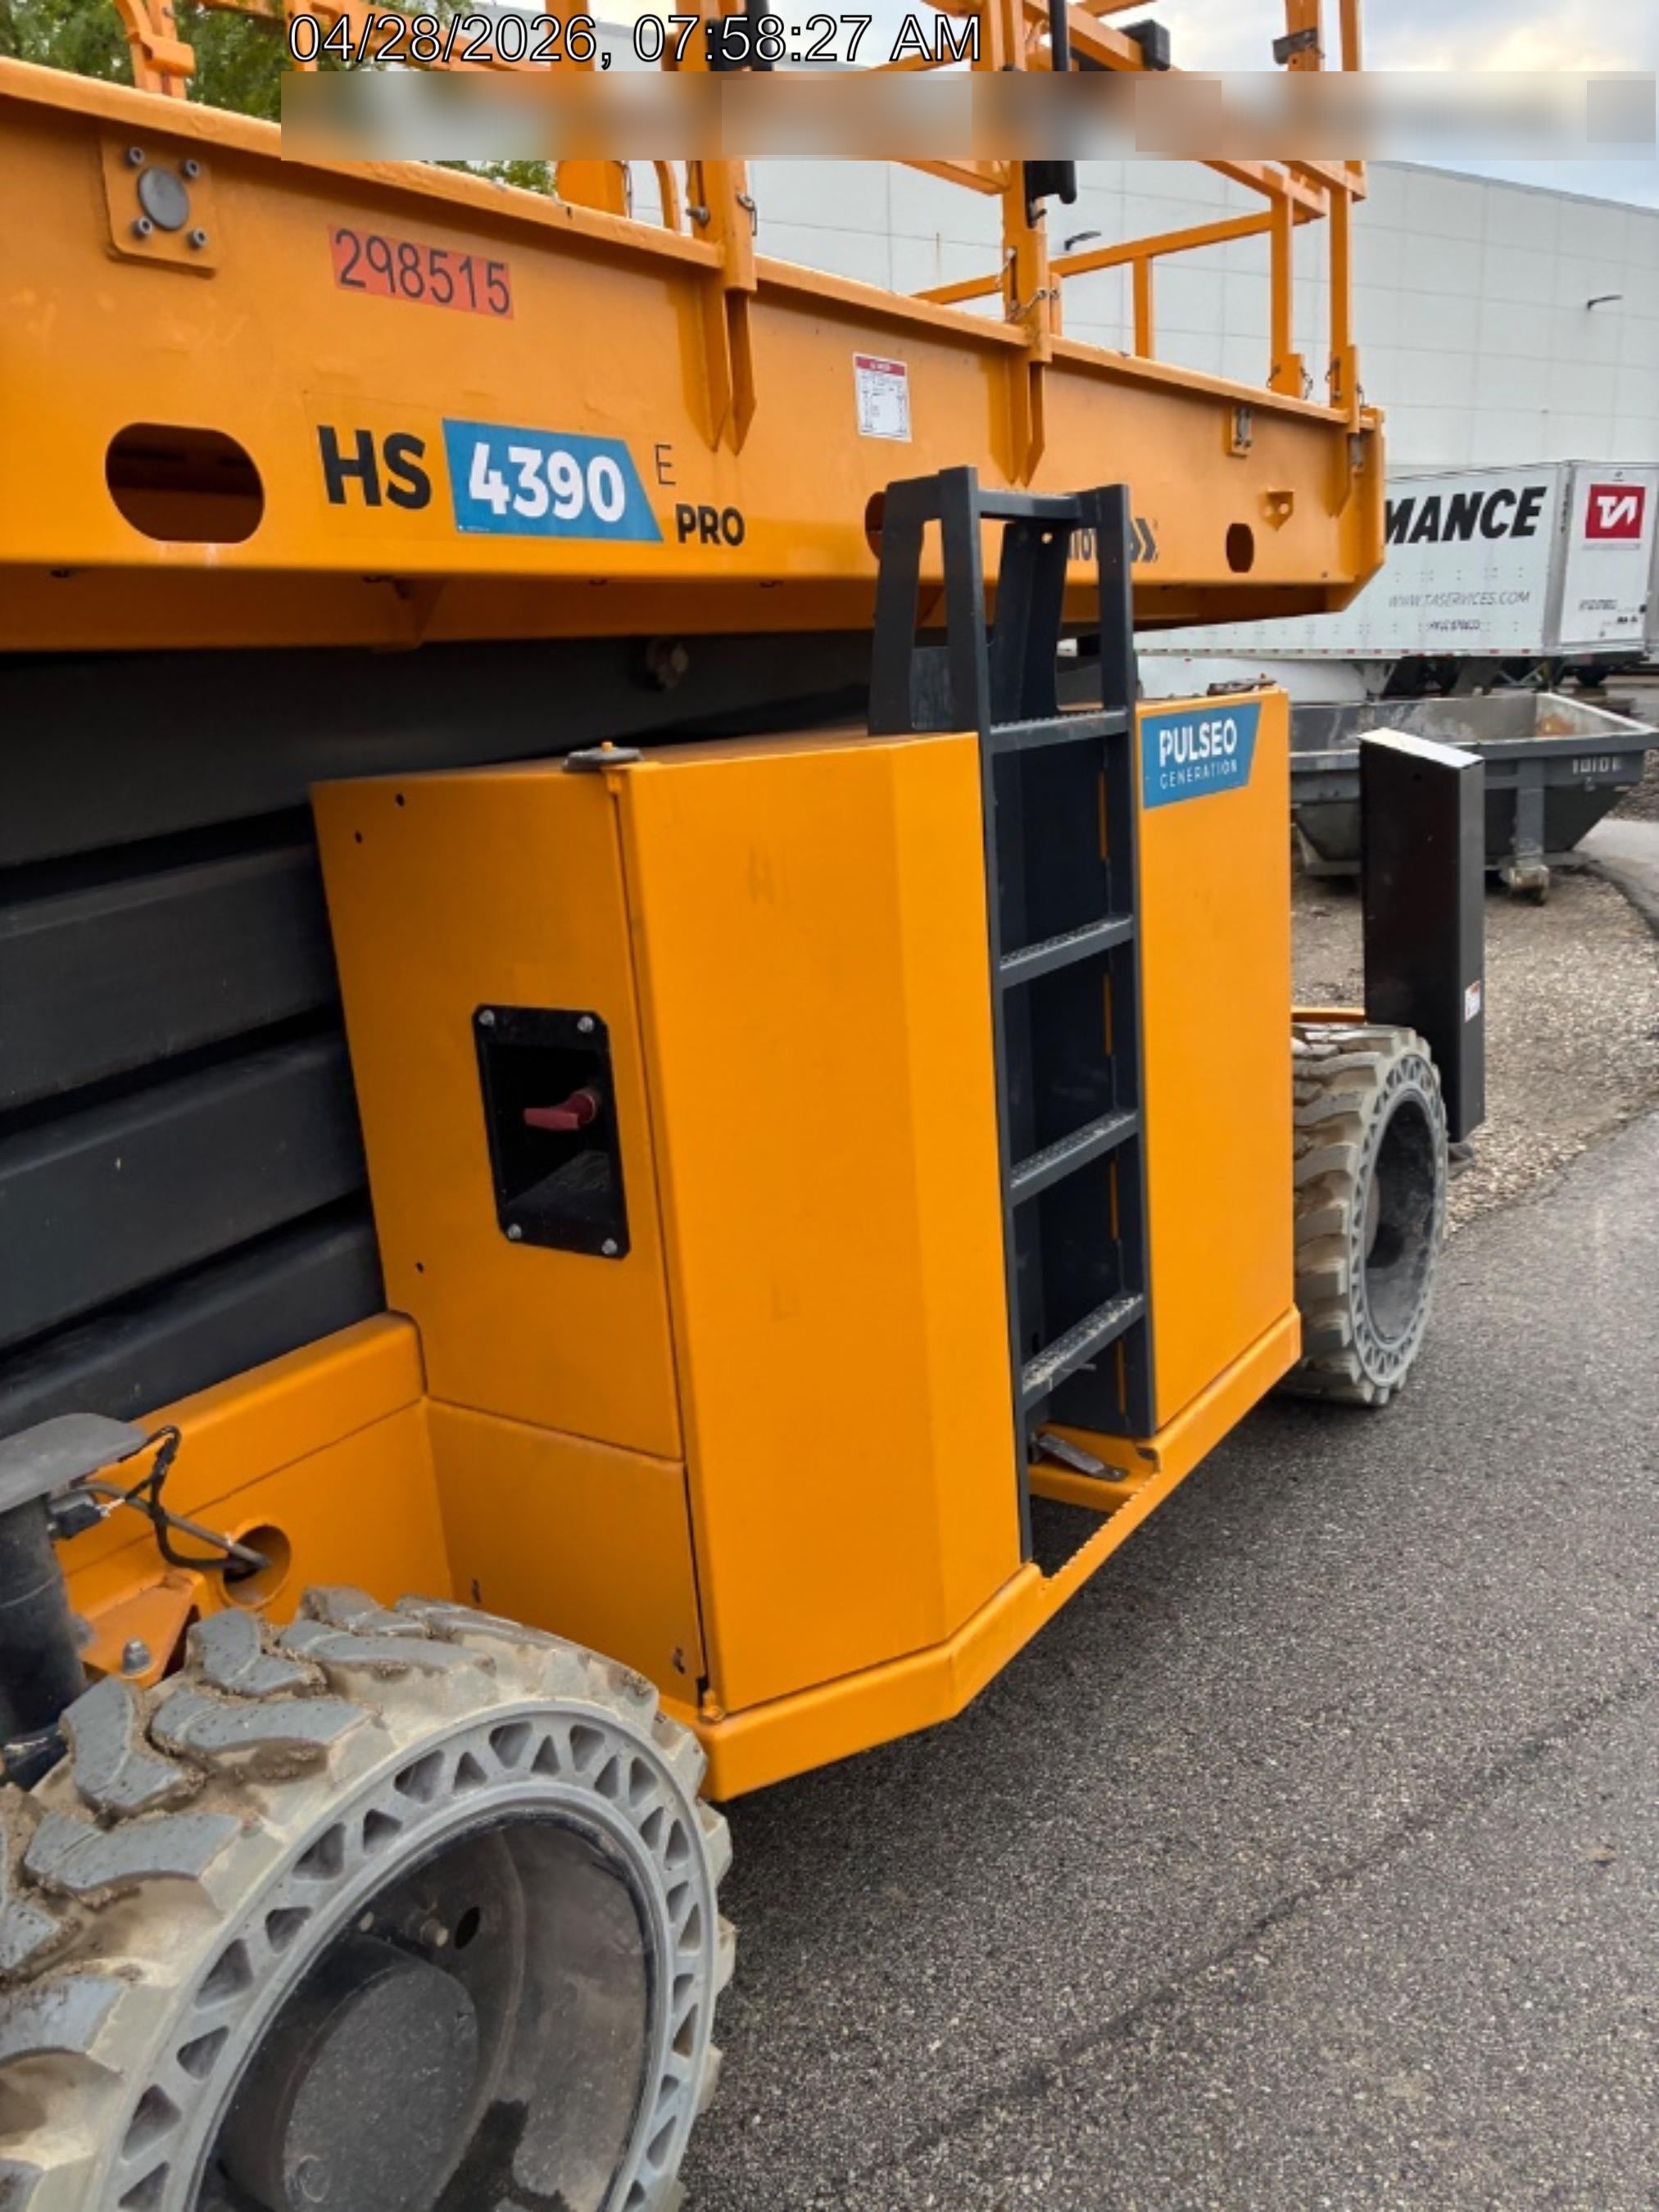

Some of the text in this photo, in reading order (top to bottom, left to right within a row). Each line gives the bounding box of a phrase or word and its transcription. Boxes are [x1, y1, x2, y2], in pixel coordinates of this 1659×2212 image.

[334, 229, 510, 315] 298515
[317, 424, 676, 523] HS 4390 E
[675, 503, 746, 546] PRO
[1158, 718, 1238, 768] PULSEO
[1159, 759, 1238, 790] GENERATION
